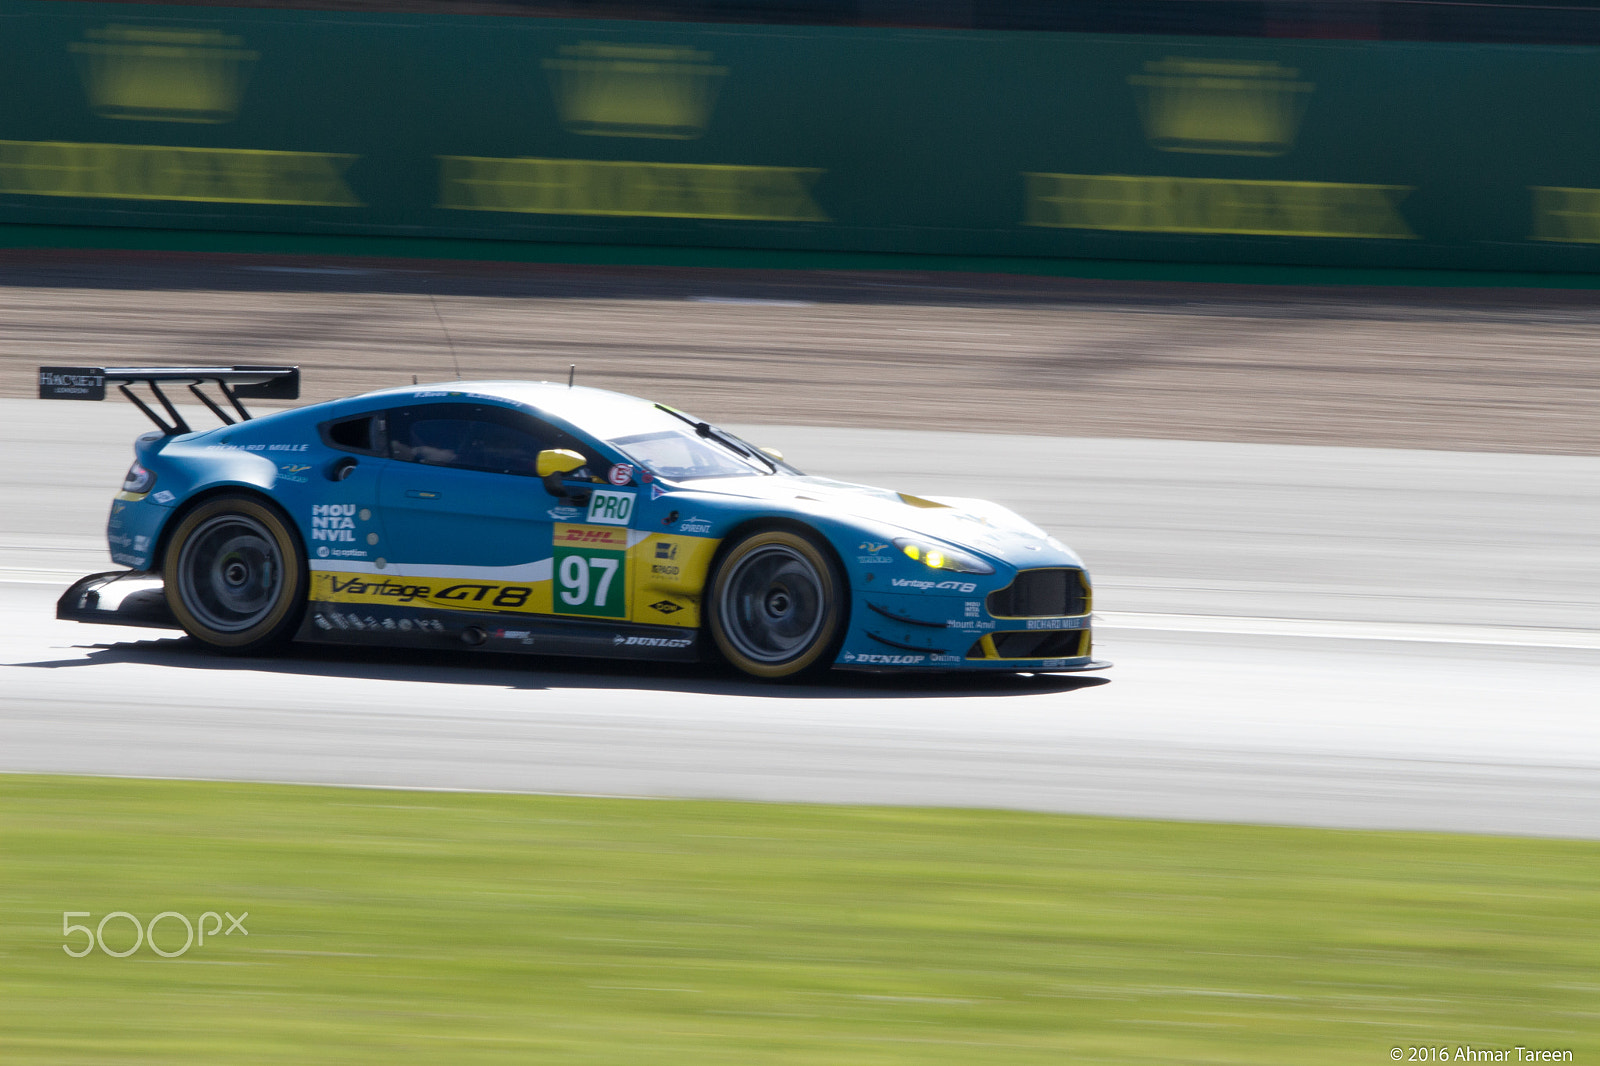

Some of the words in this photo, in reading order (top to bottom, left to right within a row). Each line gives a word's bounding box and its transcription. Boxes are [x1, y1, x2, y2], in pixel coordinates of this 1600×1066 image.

[312, 504, 356, 517] MOU
[591, 495, 630, 520] PRO
[312, 517, 356, 529] NTA
[312, 529, 356, 542] NVIL
[565, 529, 613, 544] DHL
[559, 555, 619, 607] 97
[892, 578, 936, 590] Vantage
[936, 581, 977, 593] GT8
[331, 576, 431, 602] Vantage
[434, 584, 533, 608] GT8
[624, 636, 693, 648] DUNLOP
[856, 653, 925, 664] DUNLOP
